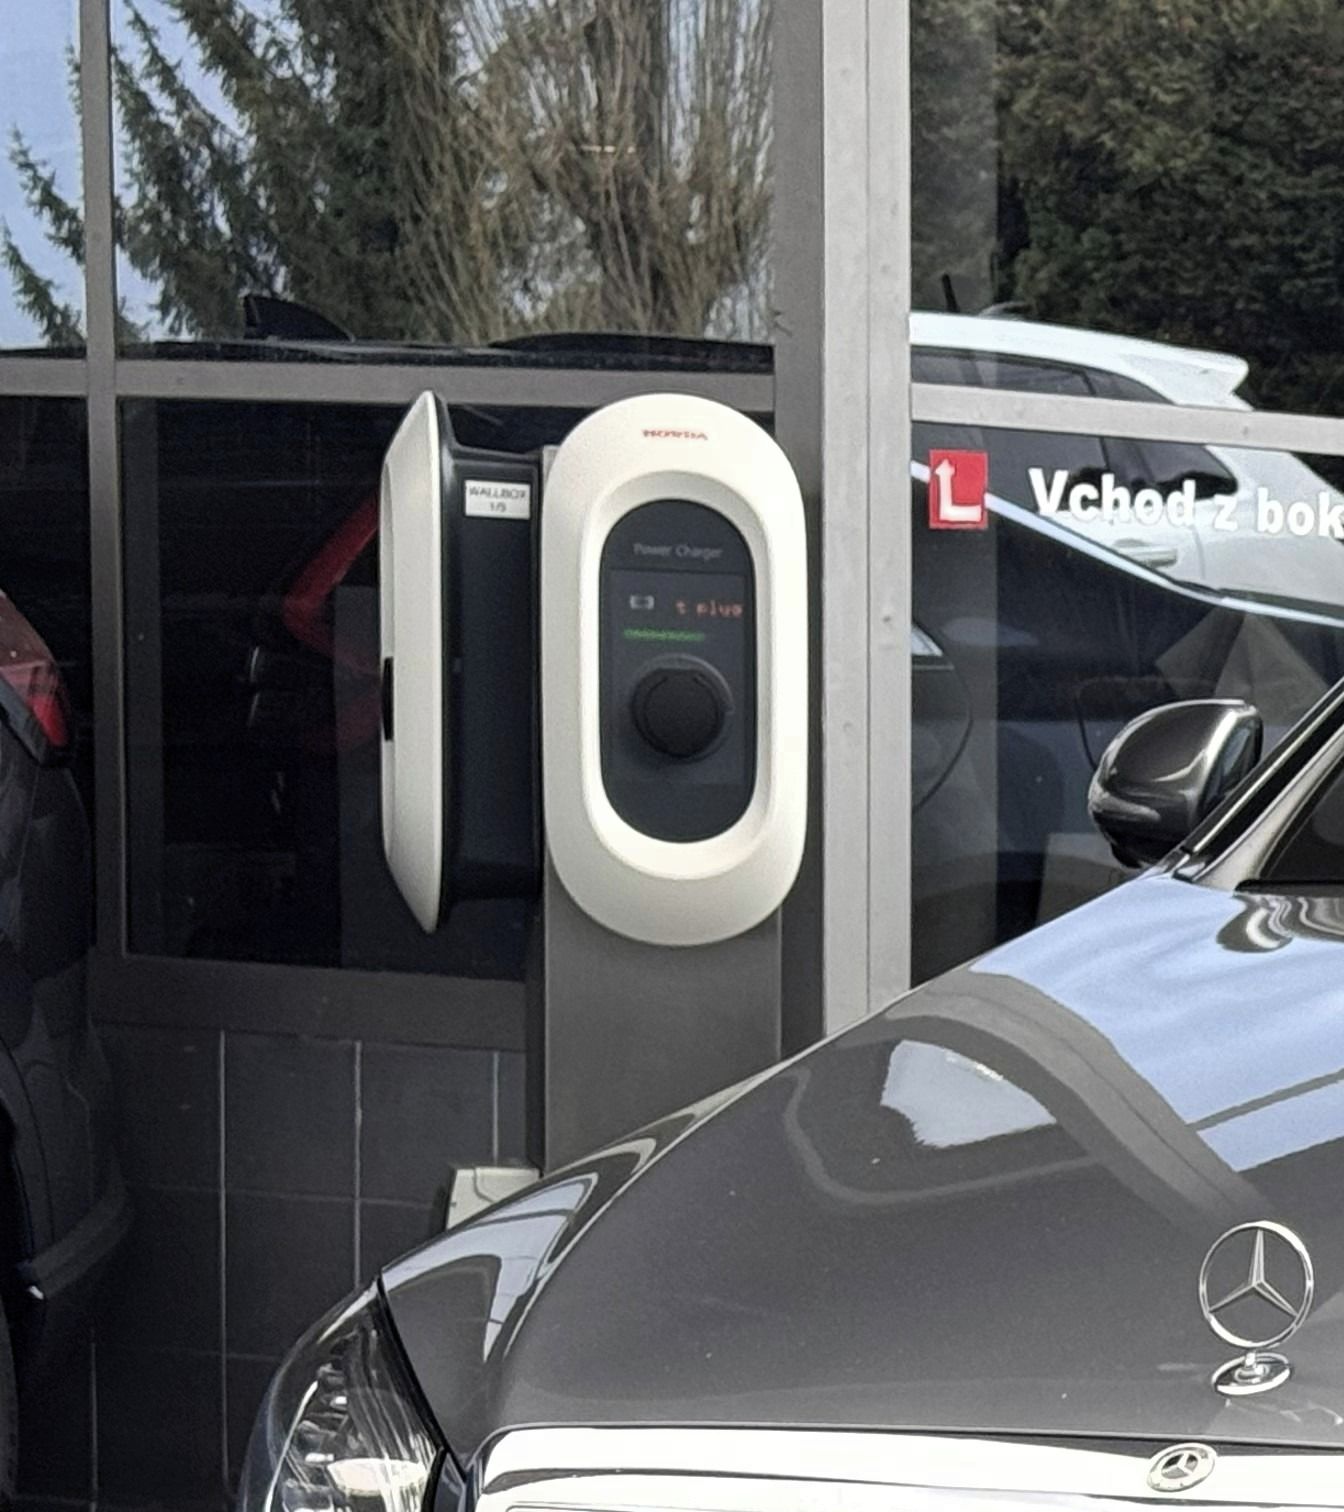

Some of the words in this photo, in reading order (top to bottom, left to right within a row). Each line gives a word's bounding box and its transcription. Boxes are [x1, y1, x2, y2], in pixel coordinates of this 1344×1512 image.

[1028, 467, 1198, 527] Vchod
[1213, 497, 1238, 532] z
[633, 543, 672, 557] Power
[675, 544, 722, 561] Charger
